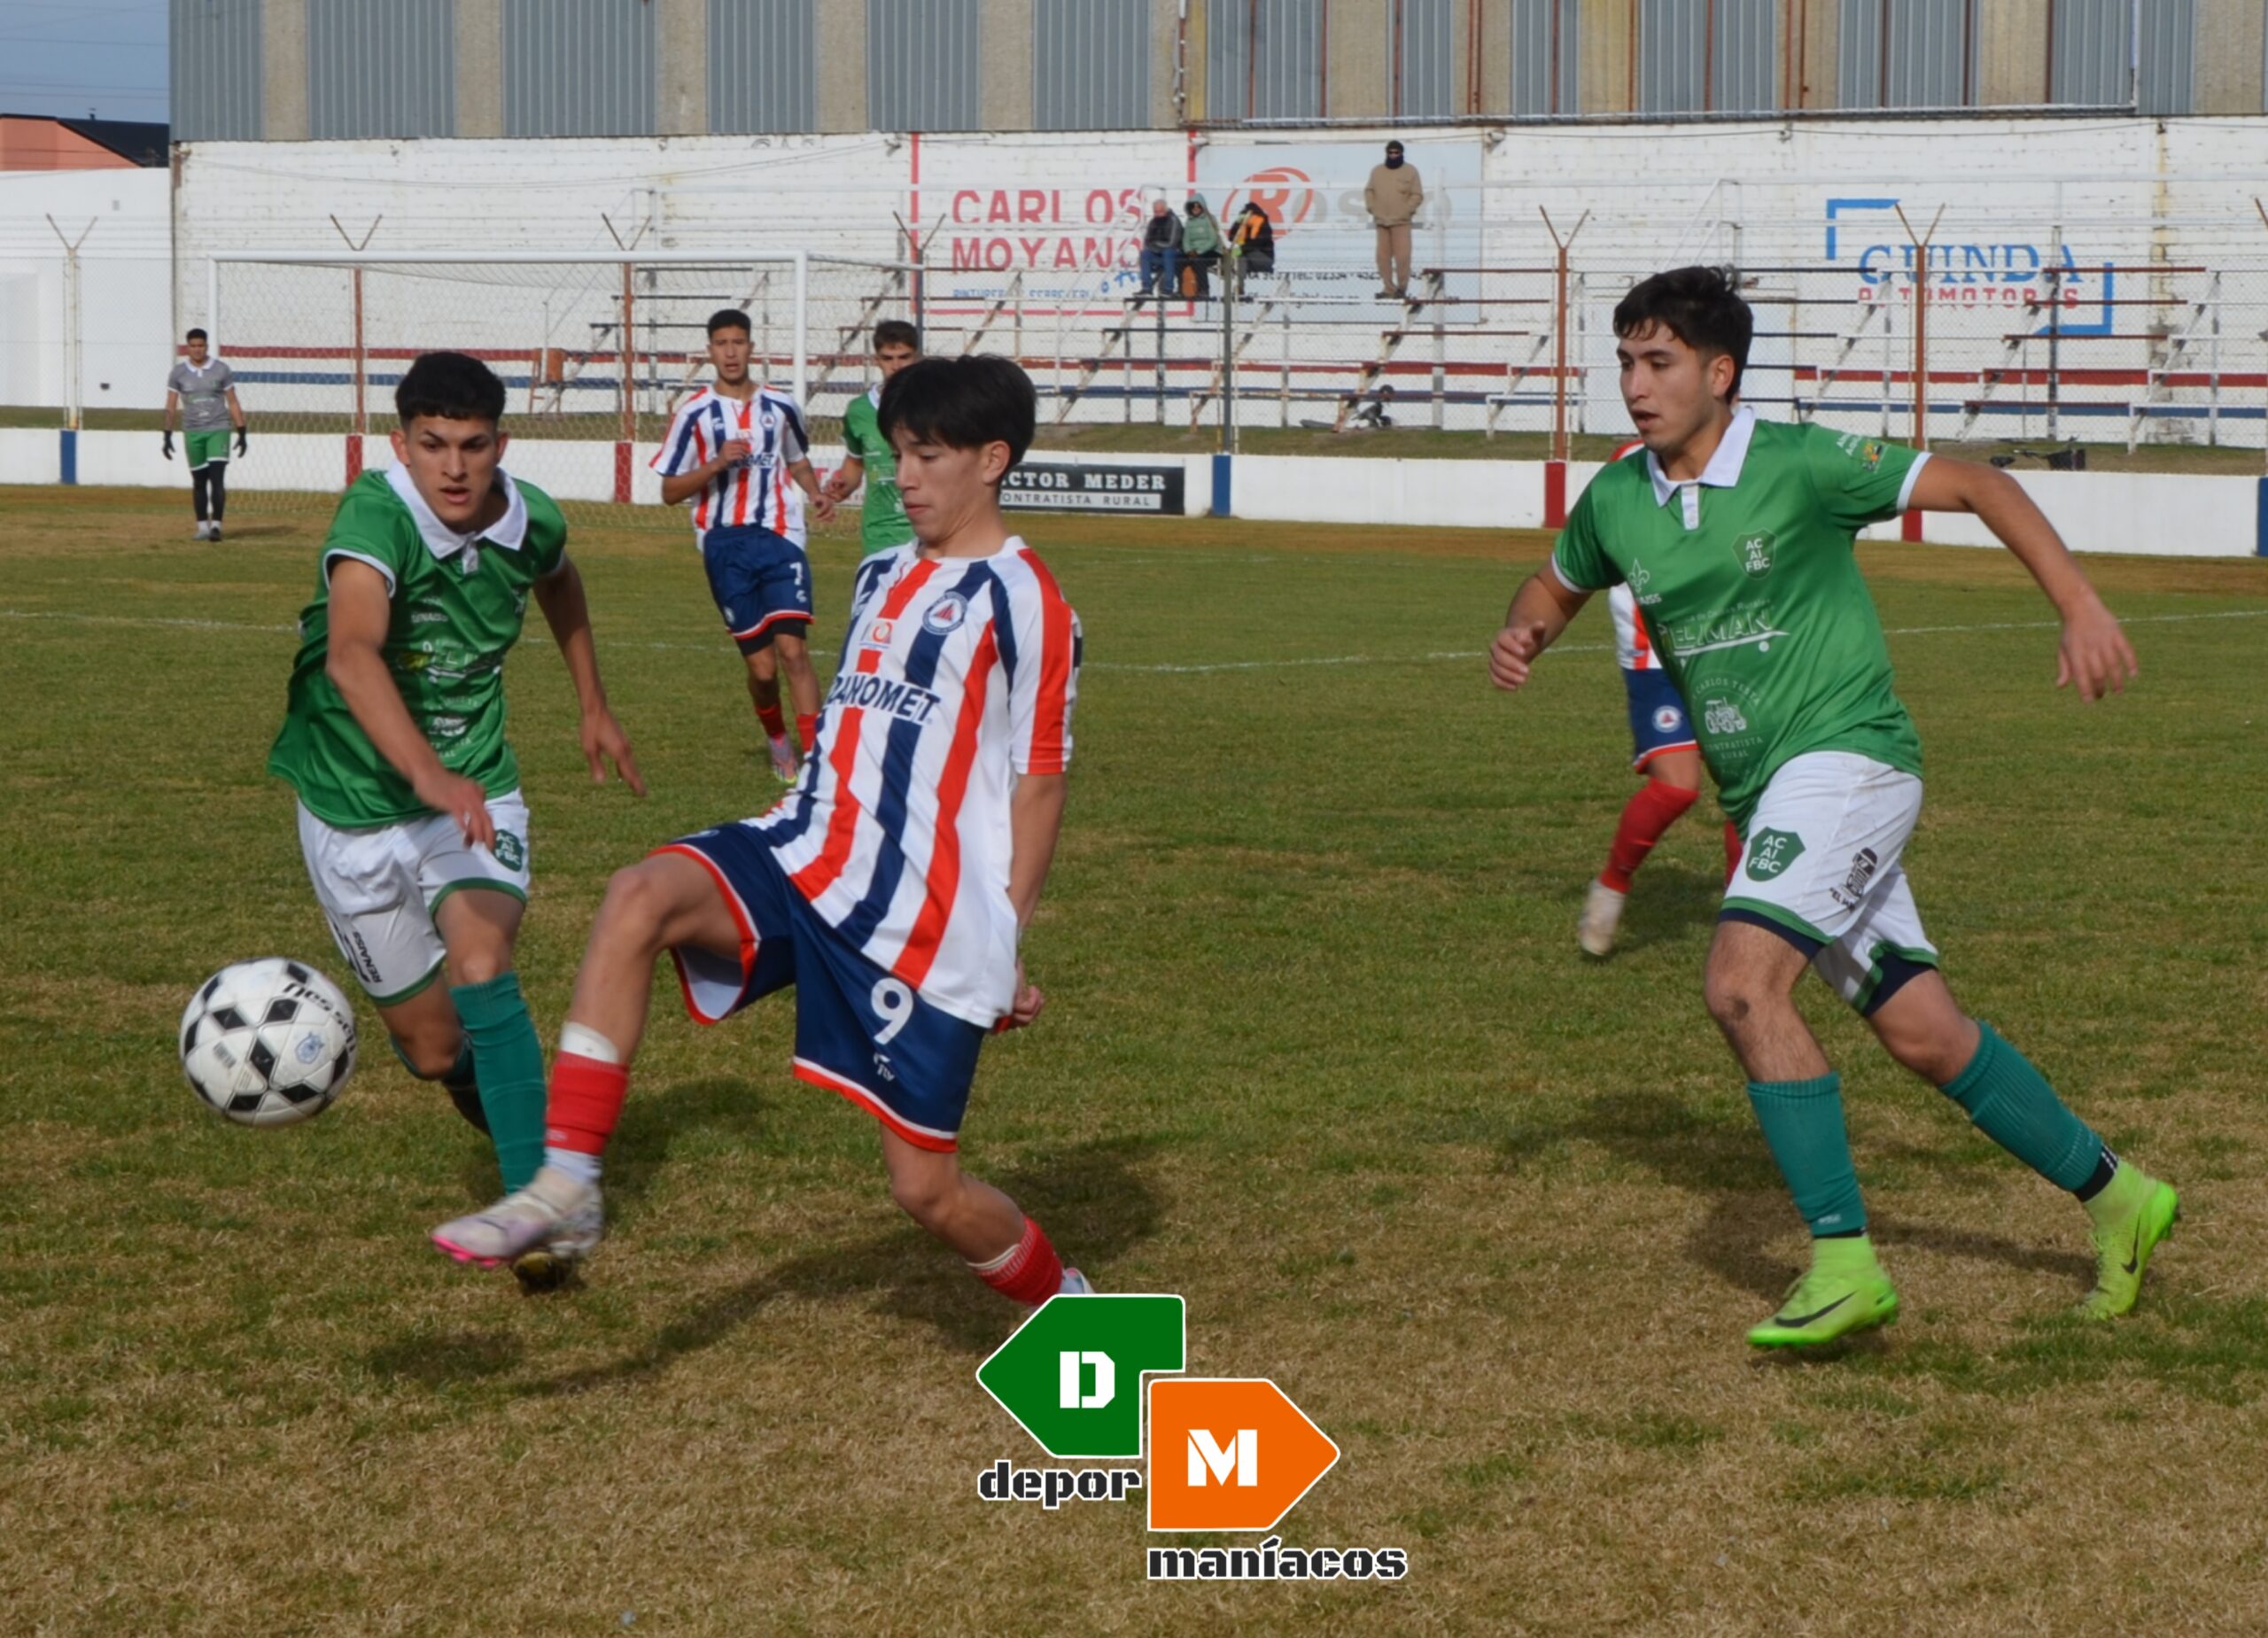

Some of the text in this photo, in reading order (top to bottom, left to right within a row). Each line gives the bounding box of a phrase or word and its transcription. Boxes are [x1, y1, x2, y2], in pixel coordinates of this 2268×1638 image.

[951, 189, 1142, 223] CARLOS
[951, 237, 1143, 270] MOYANO
[1002, 470, 1166, 490] CTOR MEDER
[1103, 495, 1150, 506] RURAL
[1745, 539, 1763, 551] AC
[1750, 549, 1763, 561] AI
[1745, 557, 1770, 572] FBC
[789, 562, 803, 586] 7
[1762, 835, 1787, 850] AC
[1759, 847, 1779, 859] AI
[1748, 857, 1782, 873] FBC
[871, 977, 913, 1045] 9
